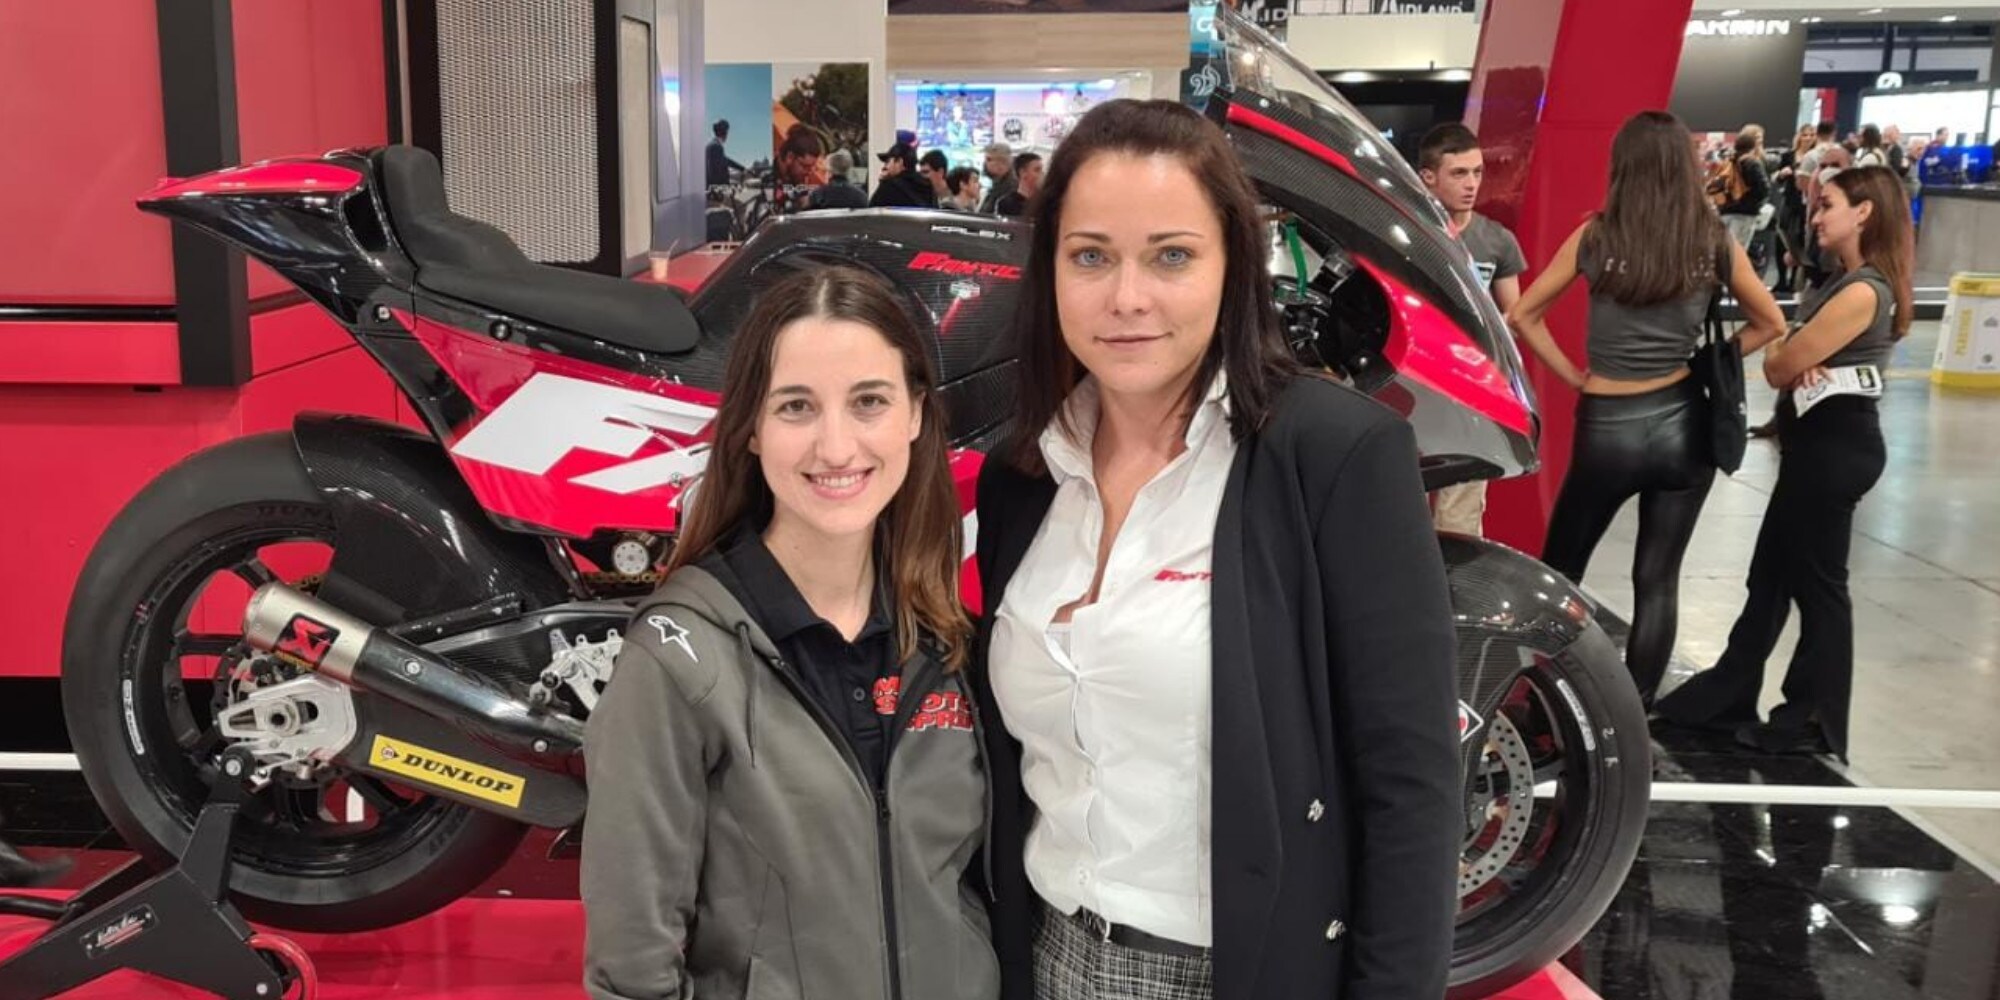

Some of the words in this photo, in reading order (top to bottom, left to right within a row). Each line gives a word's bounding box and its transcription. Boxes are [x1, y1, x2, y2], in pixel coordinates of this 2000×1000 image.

[1685, 20, 1790, 35] ARMIN
[907, 251, 1022, 279] FANTIC
[402, 753, 514, 793] DUNLOP
